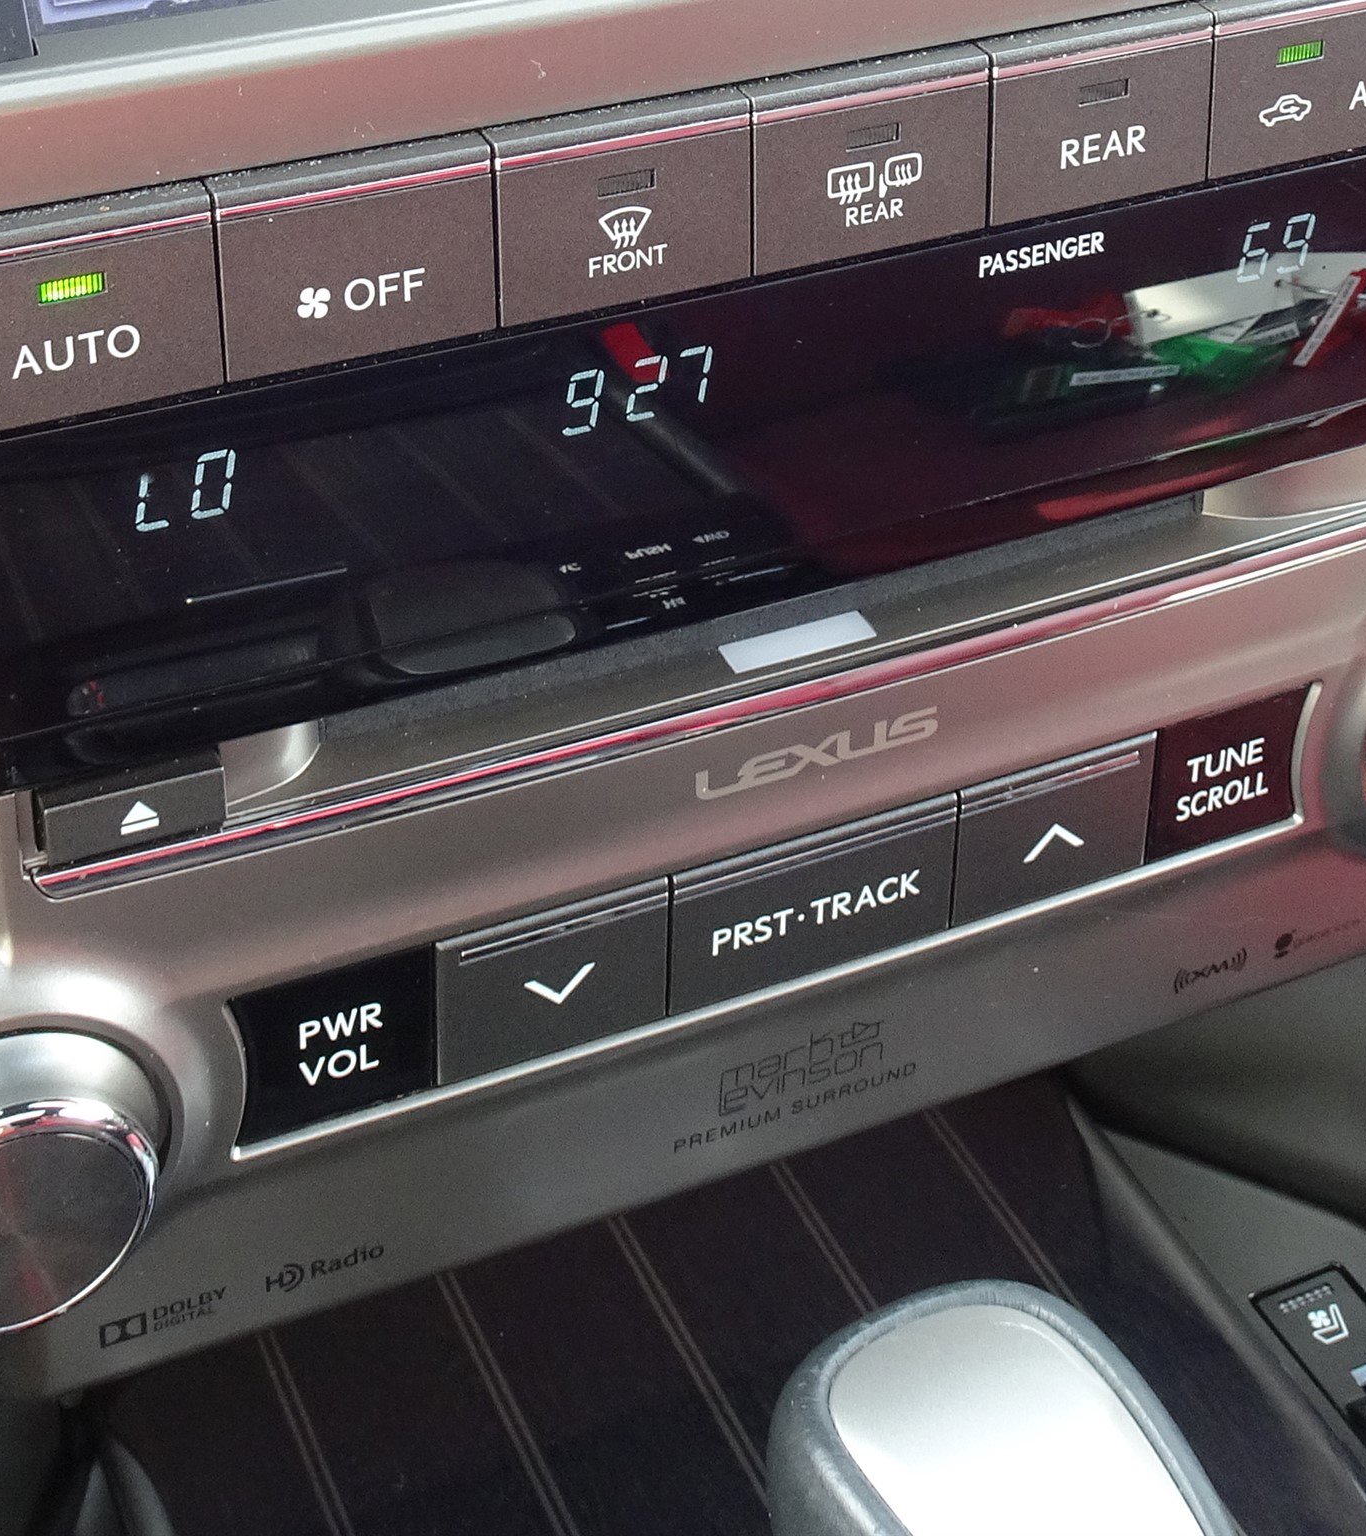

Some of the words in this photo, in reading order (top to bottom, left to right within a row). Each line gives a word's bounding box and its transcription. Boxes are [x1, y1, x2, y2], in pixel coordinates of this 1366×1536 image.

[1060, 125, 1146, 170] REAR
[844, 198, 904, 228] REAR
[588, 243, 668, 278] FRONT
[978, 231, 1105, 278] PASSENGER
[1236, 212, 1316, 283] 69
[344, 268, 425, 311] OFF
[12, 324, 141, 380] AUTO
[696, 706, 939, 801] LEXUS
[1186, 737, 1267, 783] TUNE
[1175, 771, 1269, 822] SCROLL
[298, 1002, 383, 1050] PWR
[298, 1050, 380, 1086] VOL
[673, 1107, 781, 1154] PREMIUM
[791, 1062, 916, 1115] SURROUND
[310, 1244, 385, 1280] Radio
[152, 1286, 227, 1322] DOLBY
[153, 1305, 216, 1332] DIGITAL
